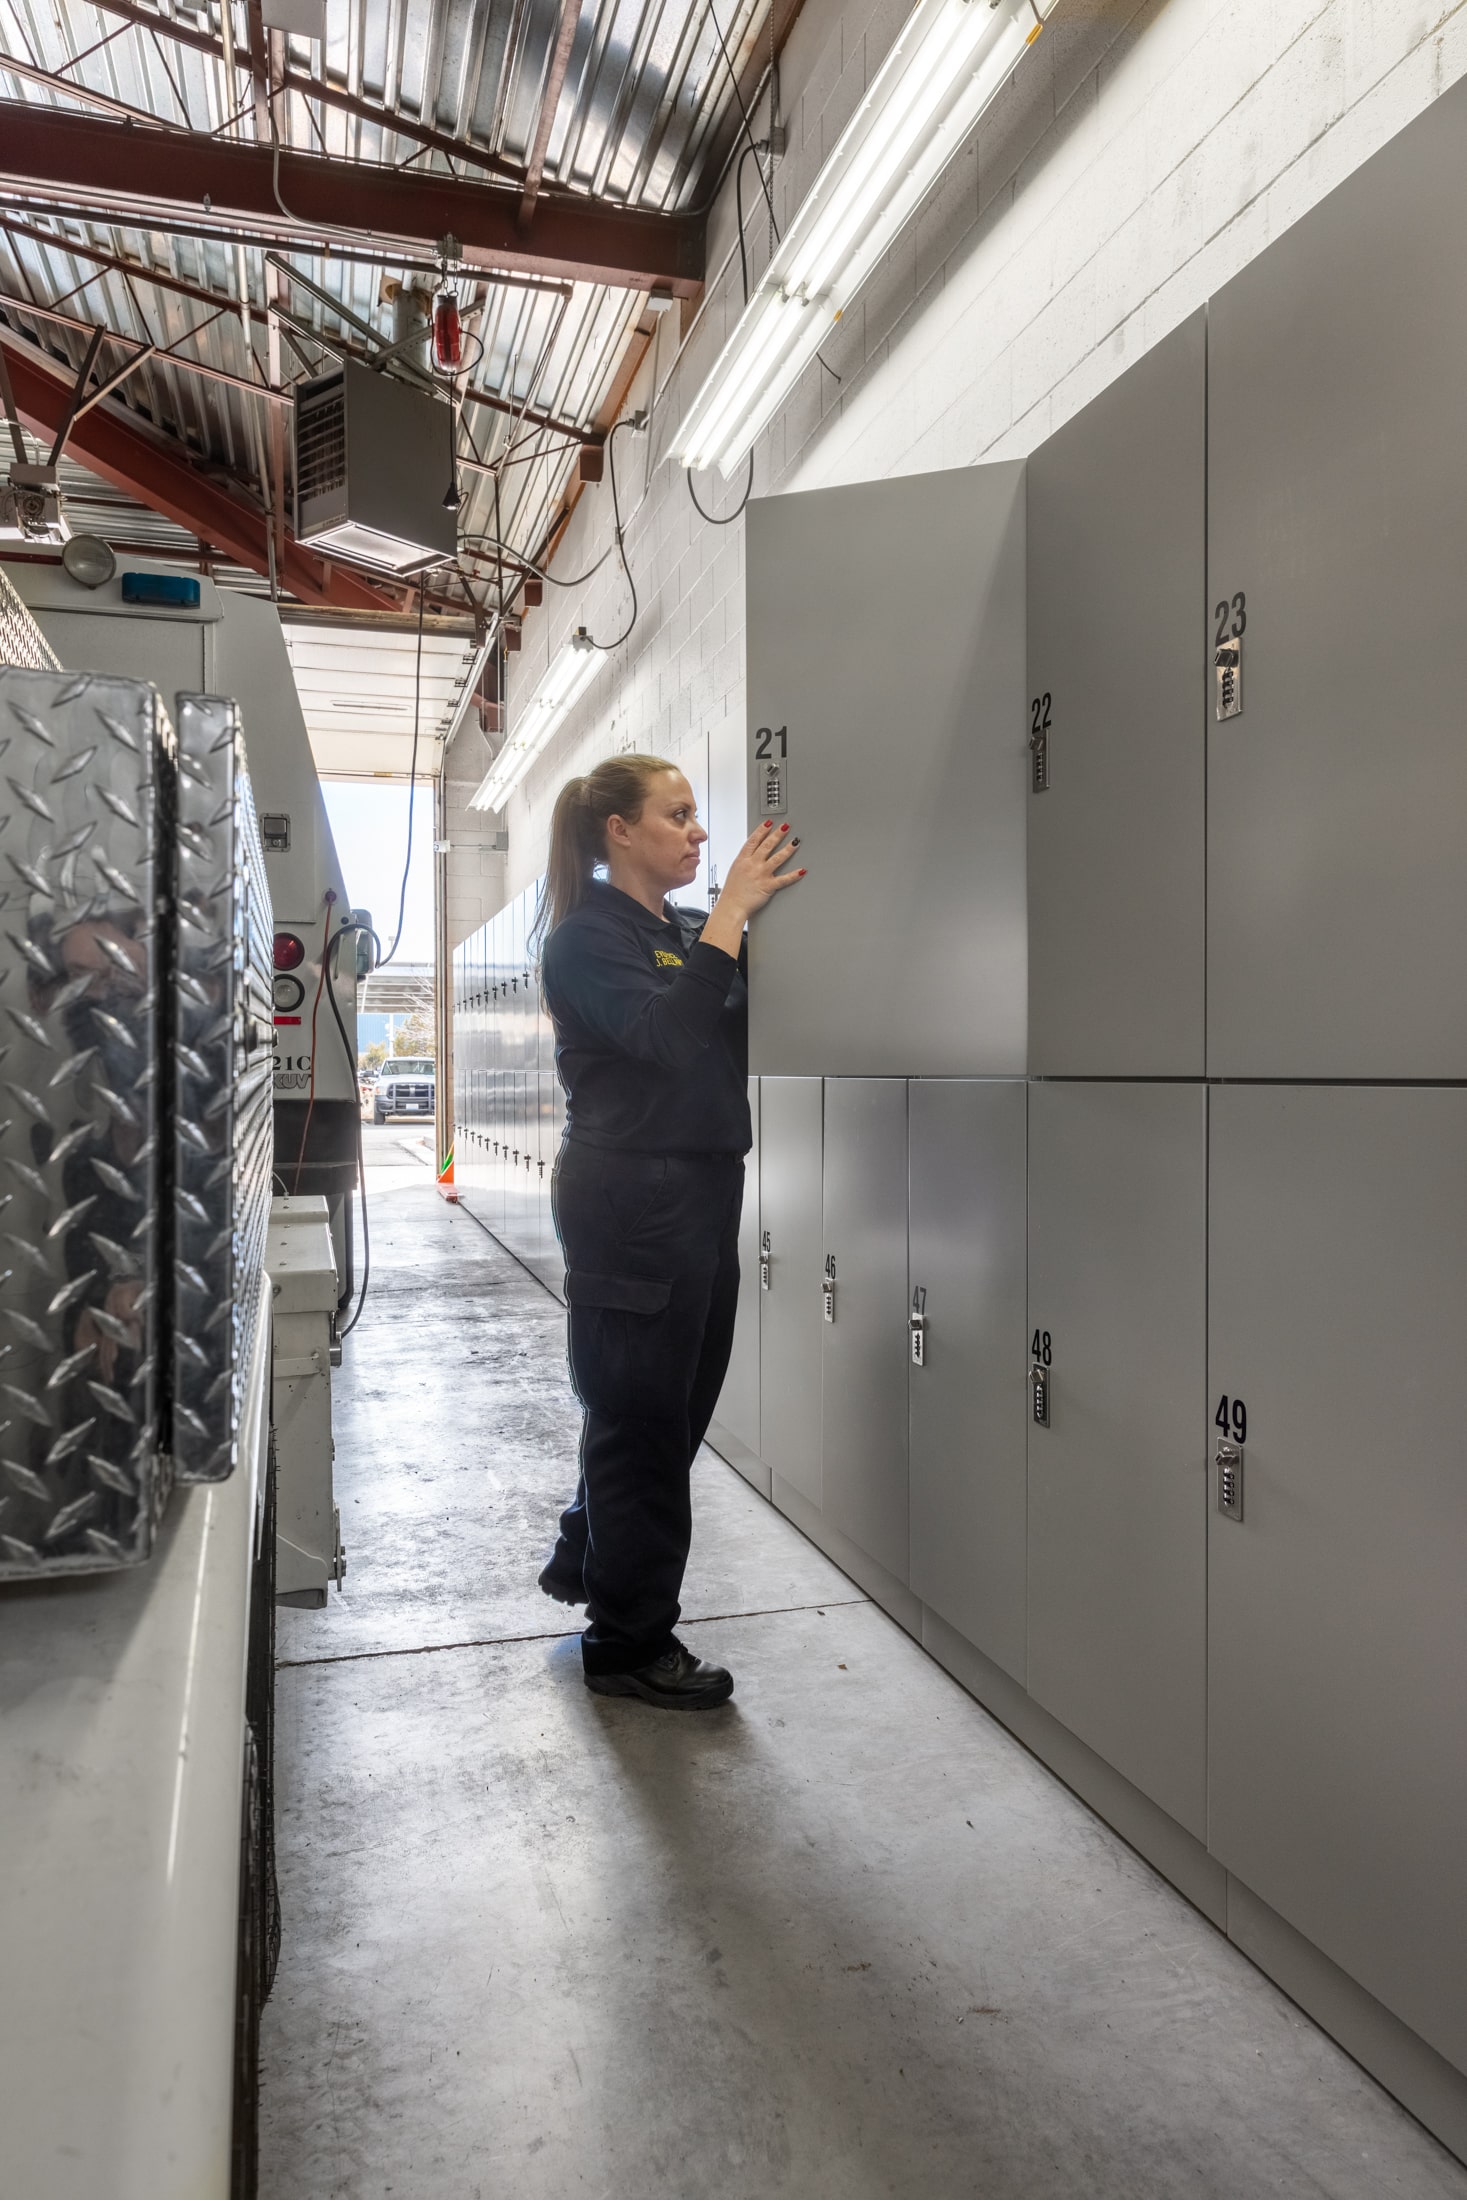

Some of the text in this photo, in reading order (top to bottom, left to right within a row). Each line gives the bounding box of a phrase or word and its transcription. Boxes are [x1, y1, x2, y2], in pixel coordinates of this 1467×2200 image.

[1215, 592, 1246, 647] 23
[1032, 692, 1051, 734] 22
[755, 726, 787, 760] 21
[762, 1230, 771, 1253] 45
[825, 1254, 836, 1280] 46
[912, 1285, 927, 1316] 47
[1032, 1329, 1052, 1367] 48
[1216, 1395, 1247, 1444] 49
